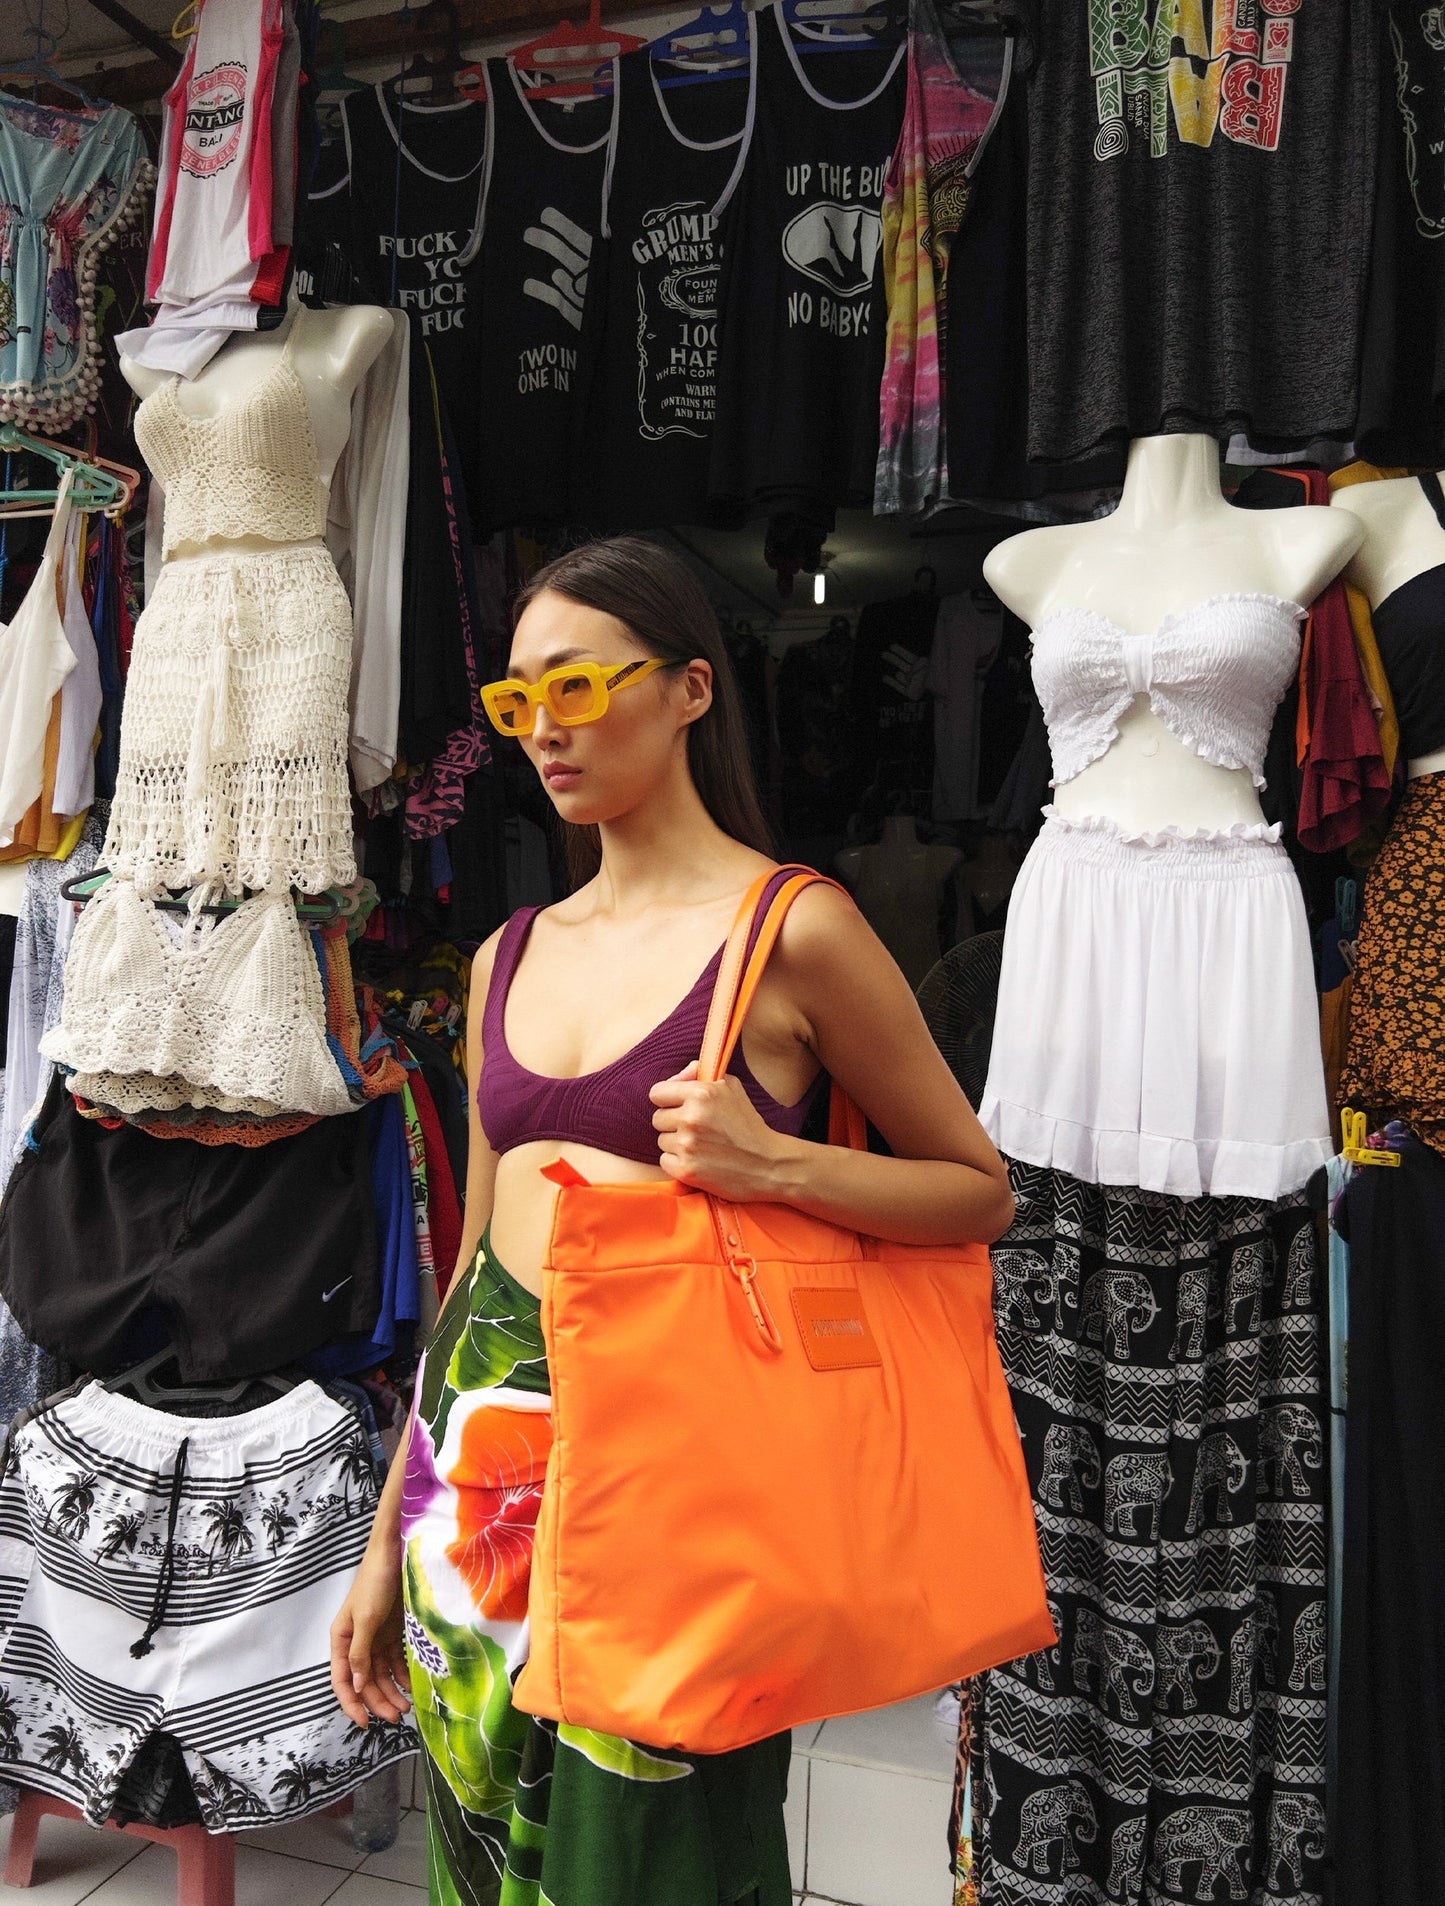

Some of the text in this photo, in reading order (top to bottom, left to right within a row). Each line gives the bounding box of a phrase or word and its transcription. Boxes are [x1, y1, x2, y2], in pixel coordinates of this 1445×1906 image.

[1127, 96, 1135, 121] UBUD
[1134, 94, 1143, 128] SANUR
[199, 133, 223, 147] BALI
[785, 163, 812, 196] UP
[818, 162, 853, 200] THE
[378, 230, 459, 259] FUCK
[631, 213, 720, 265] GRUMP
[667, 242, 714, 266] MEN'S
[684, 279, 718, 290] FOUN
[787, 291, 813, 329] NO
[518, 343, 577, 373] TWO IN
[518, 367, 570, 395] ONE IN
[655, 366, 716, 382] WHEN COM
[685, 383, 717, 397] WARN
[660, 396, 701, 410] CONTAINS
[674, 408, 694, 418] AND
